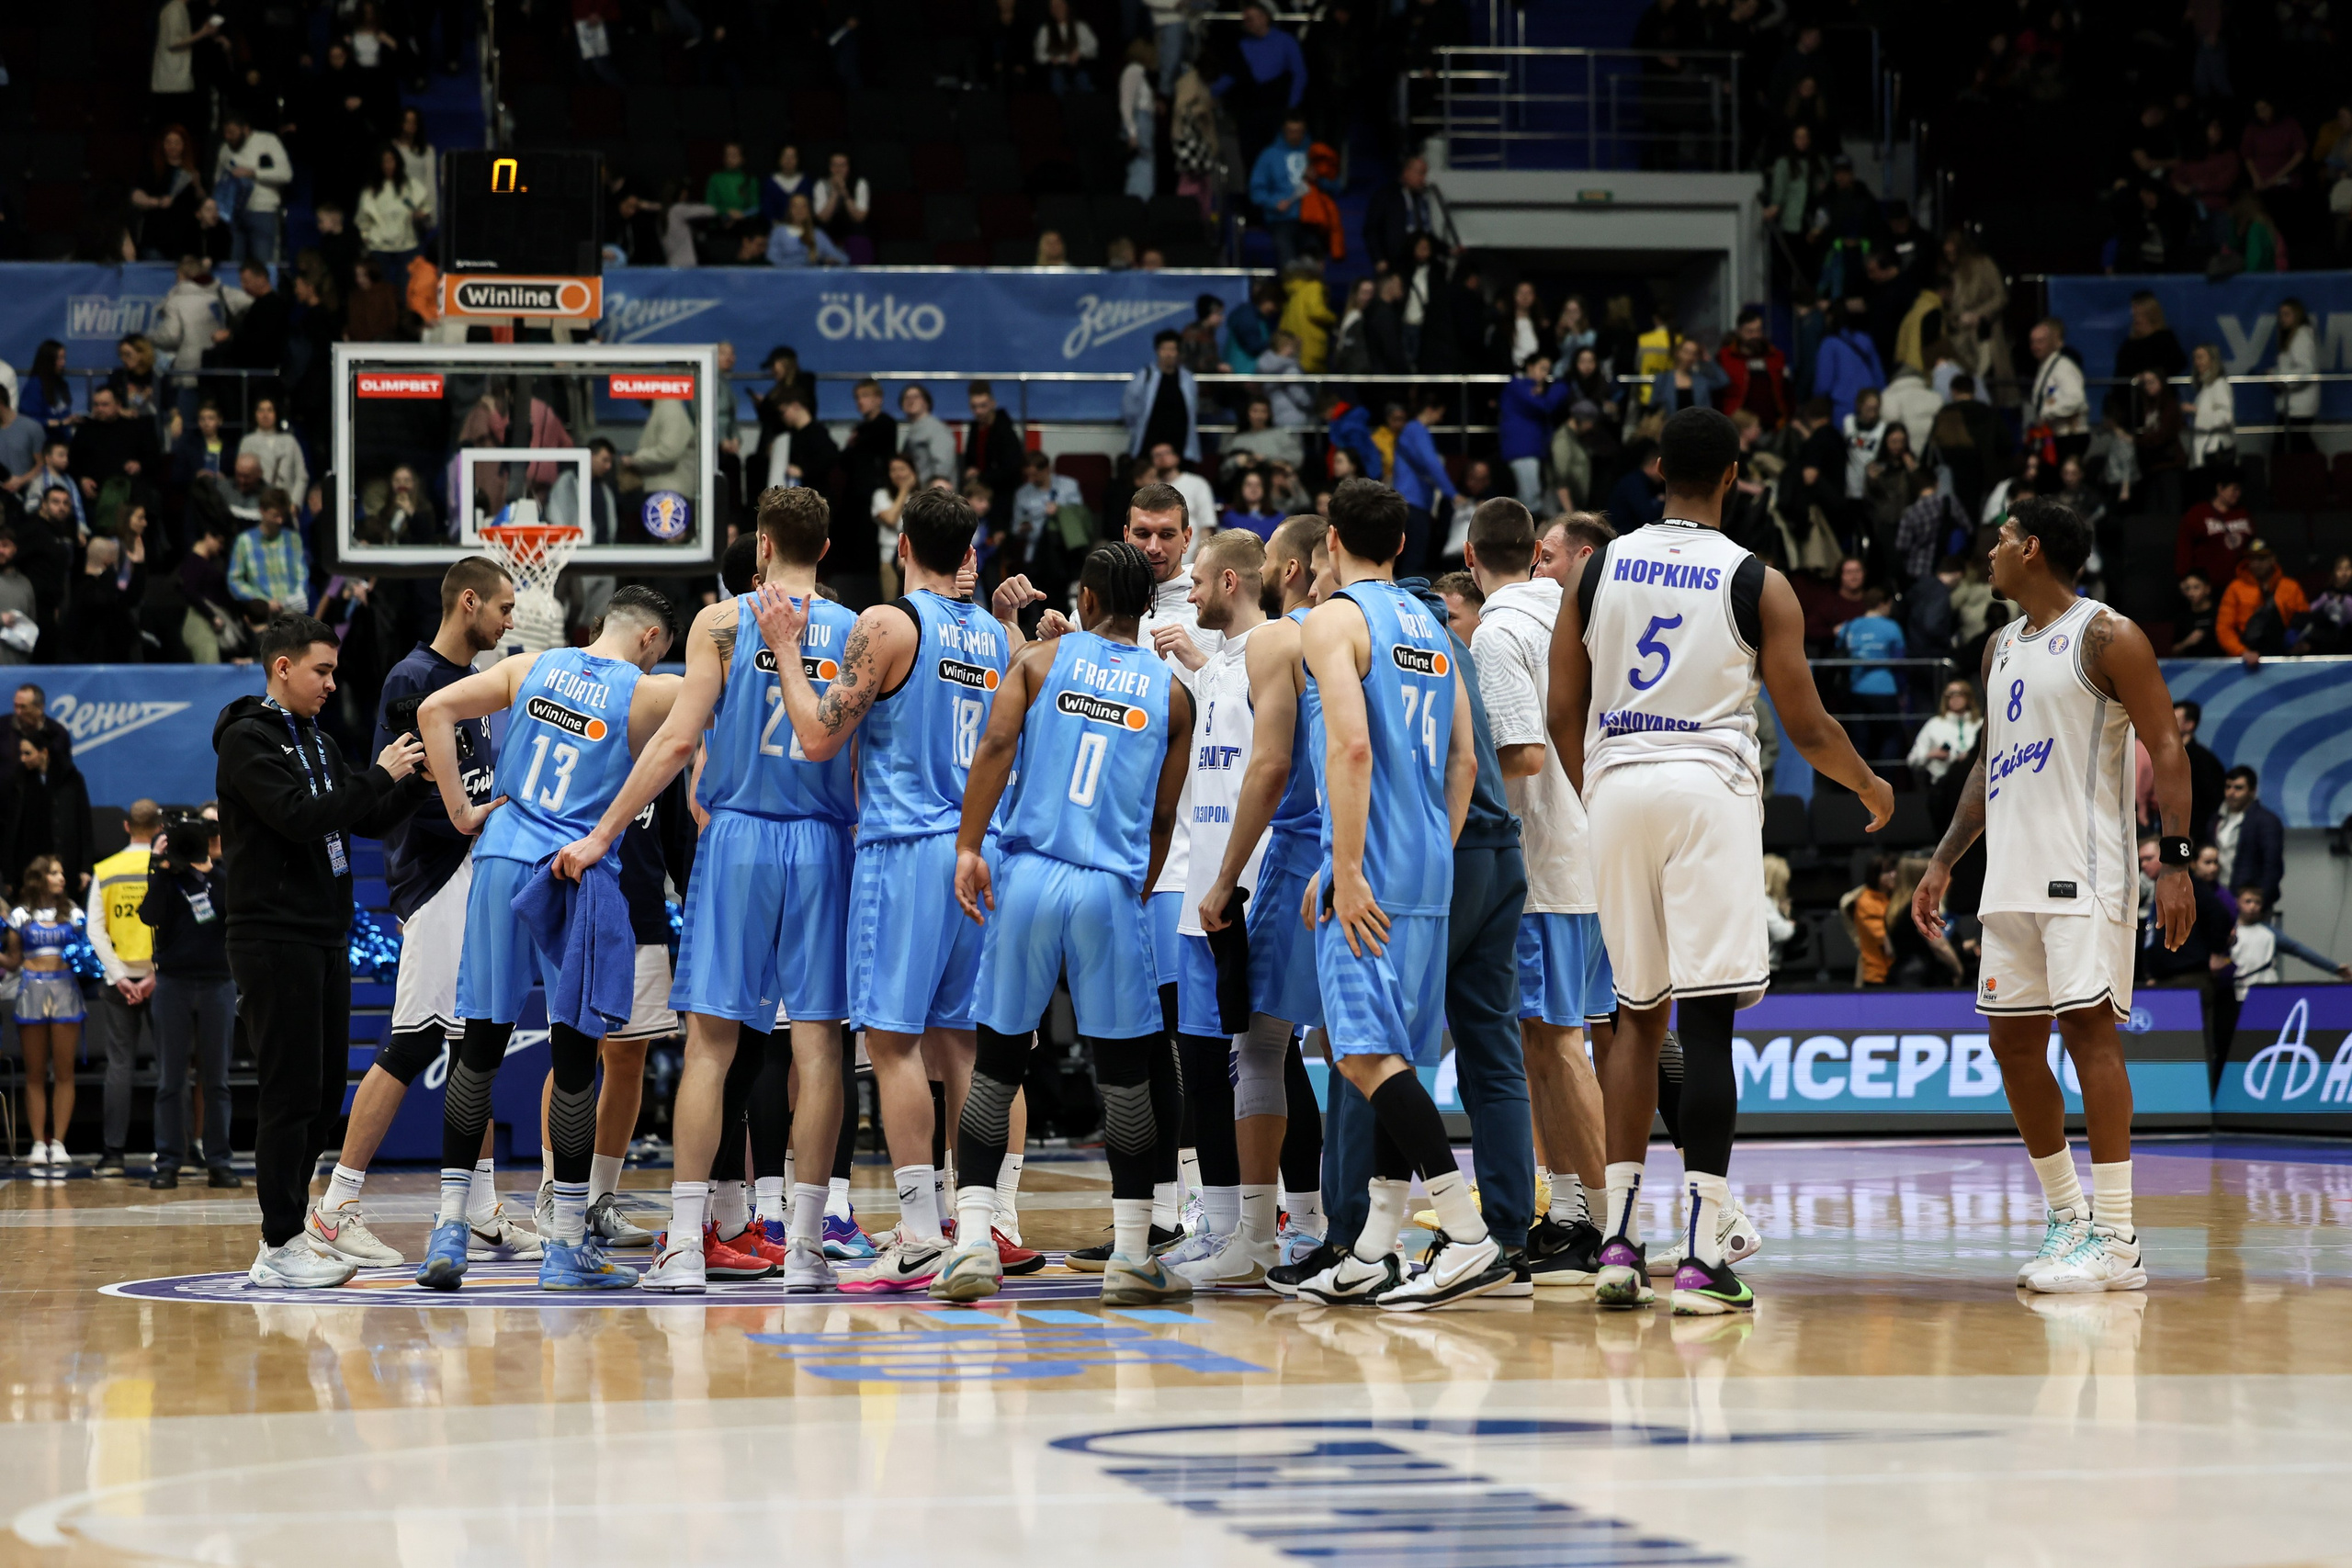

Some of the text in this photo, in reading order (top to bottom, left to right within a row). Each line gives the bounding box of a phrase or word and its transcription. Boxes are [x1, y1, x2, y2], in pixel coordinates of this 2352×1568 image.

[466, 286, 552, 308] Winline
[360, 379, 439, 393] OLIMPBET
[612, 379, 692, 394] OLIMPBET
[1613, 558, 1721, 591] HOPKINS
[1628, 613, 1682, 691] 5
[543, 668, 611, 710] HEURTEL
[1072, 658, 1150, 698] FRAZIER
[533, 701, 582, 731] Winline
[1065, 696, 1121, 721] Winline
[2007, 679, 2024, 722] 8
[952, 695, 984, 770] 18
[521, 735, 580, 812] 13
[1069, 731, 1108, 807] 0
[1989, 738, 2054, 801] Enisey
[2179, 842, 2190, 857] 8
